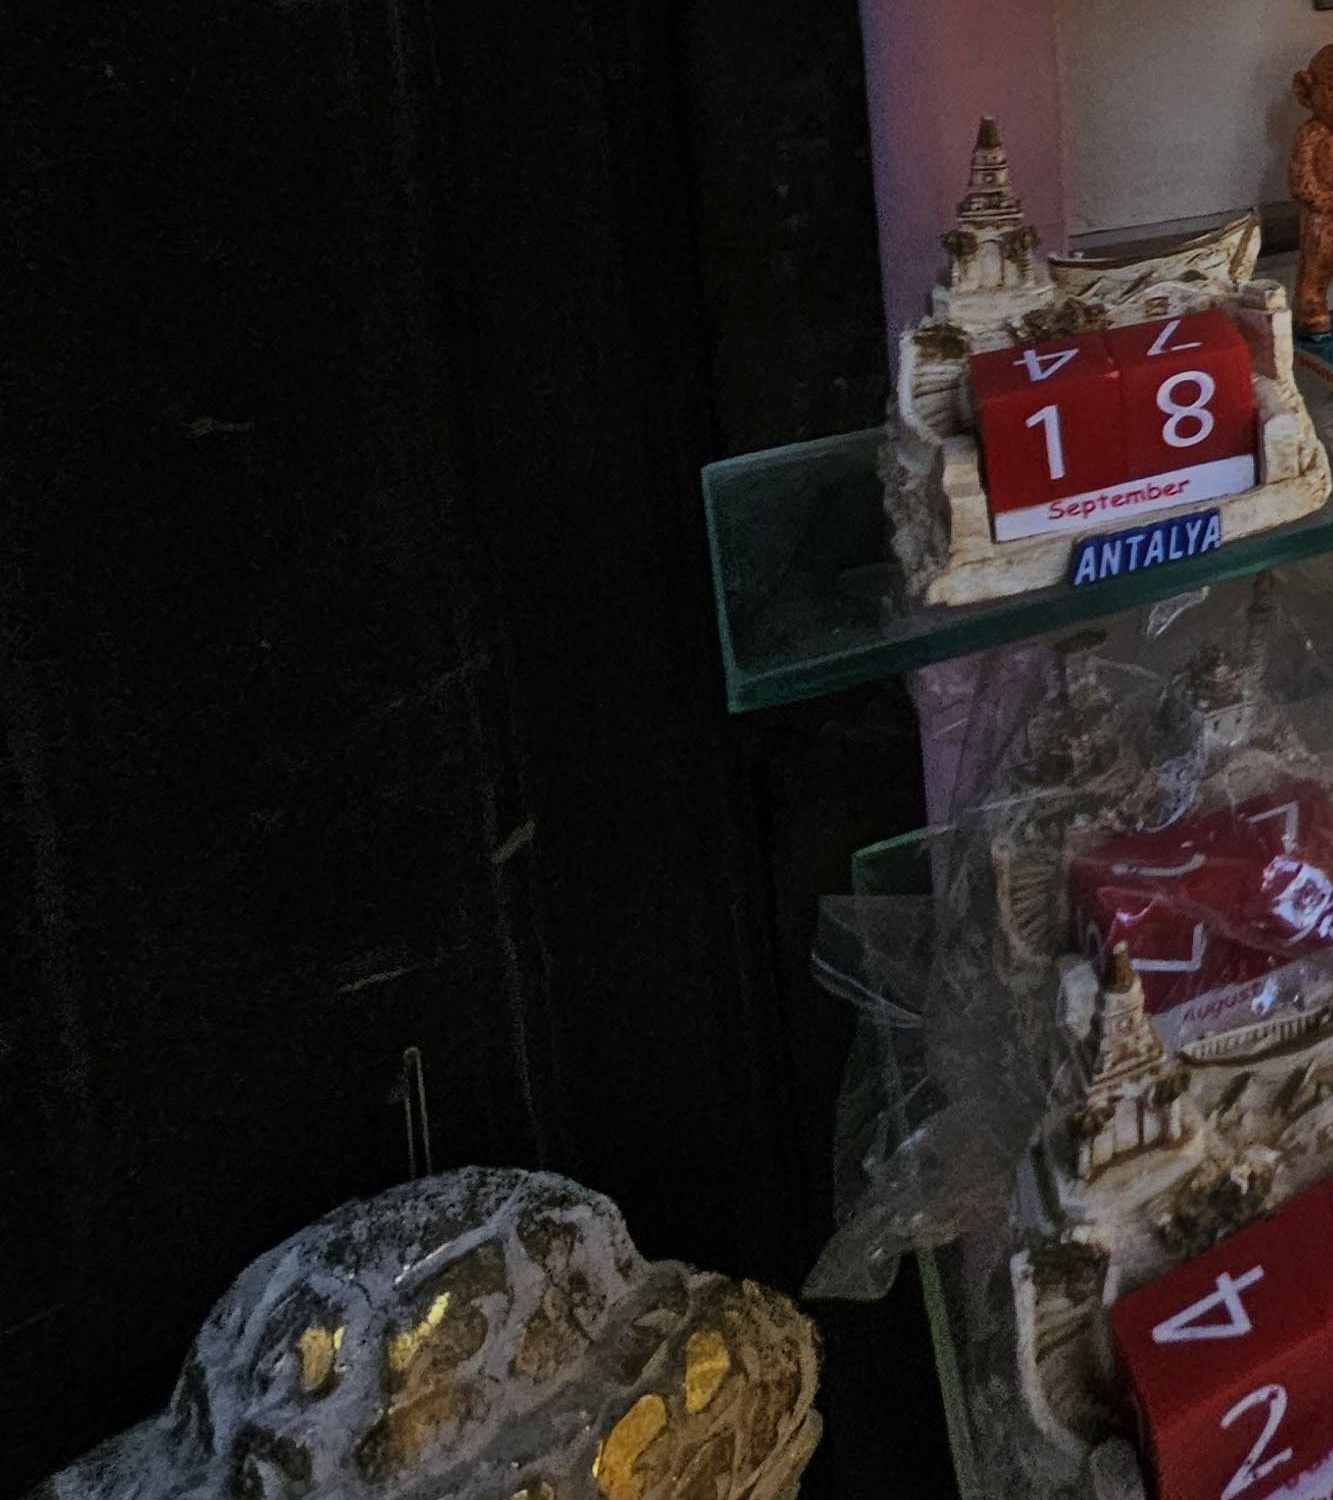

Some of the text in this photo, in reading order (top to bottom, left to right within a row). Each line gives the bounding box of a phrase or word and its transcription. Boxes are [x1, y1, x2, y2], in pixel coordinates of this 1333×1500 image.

[1013, 348, 1079, 382] 4
[1025, 370, 1216, 480] 1 8
[1047, 477, 1191, 521] September
[1074, 512, 1223, 586] ANTALYA
[1152, 1265, 1265, 1343] 4
[1221, 1384, 1293, 1500] 2
